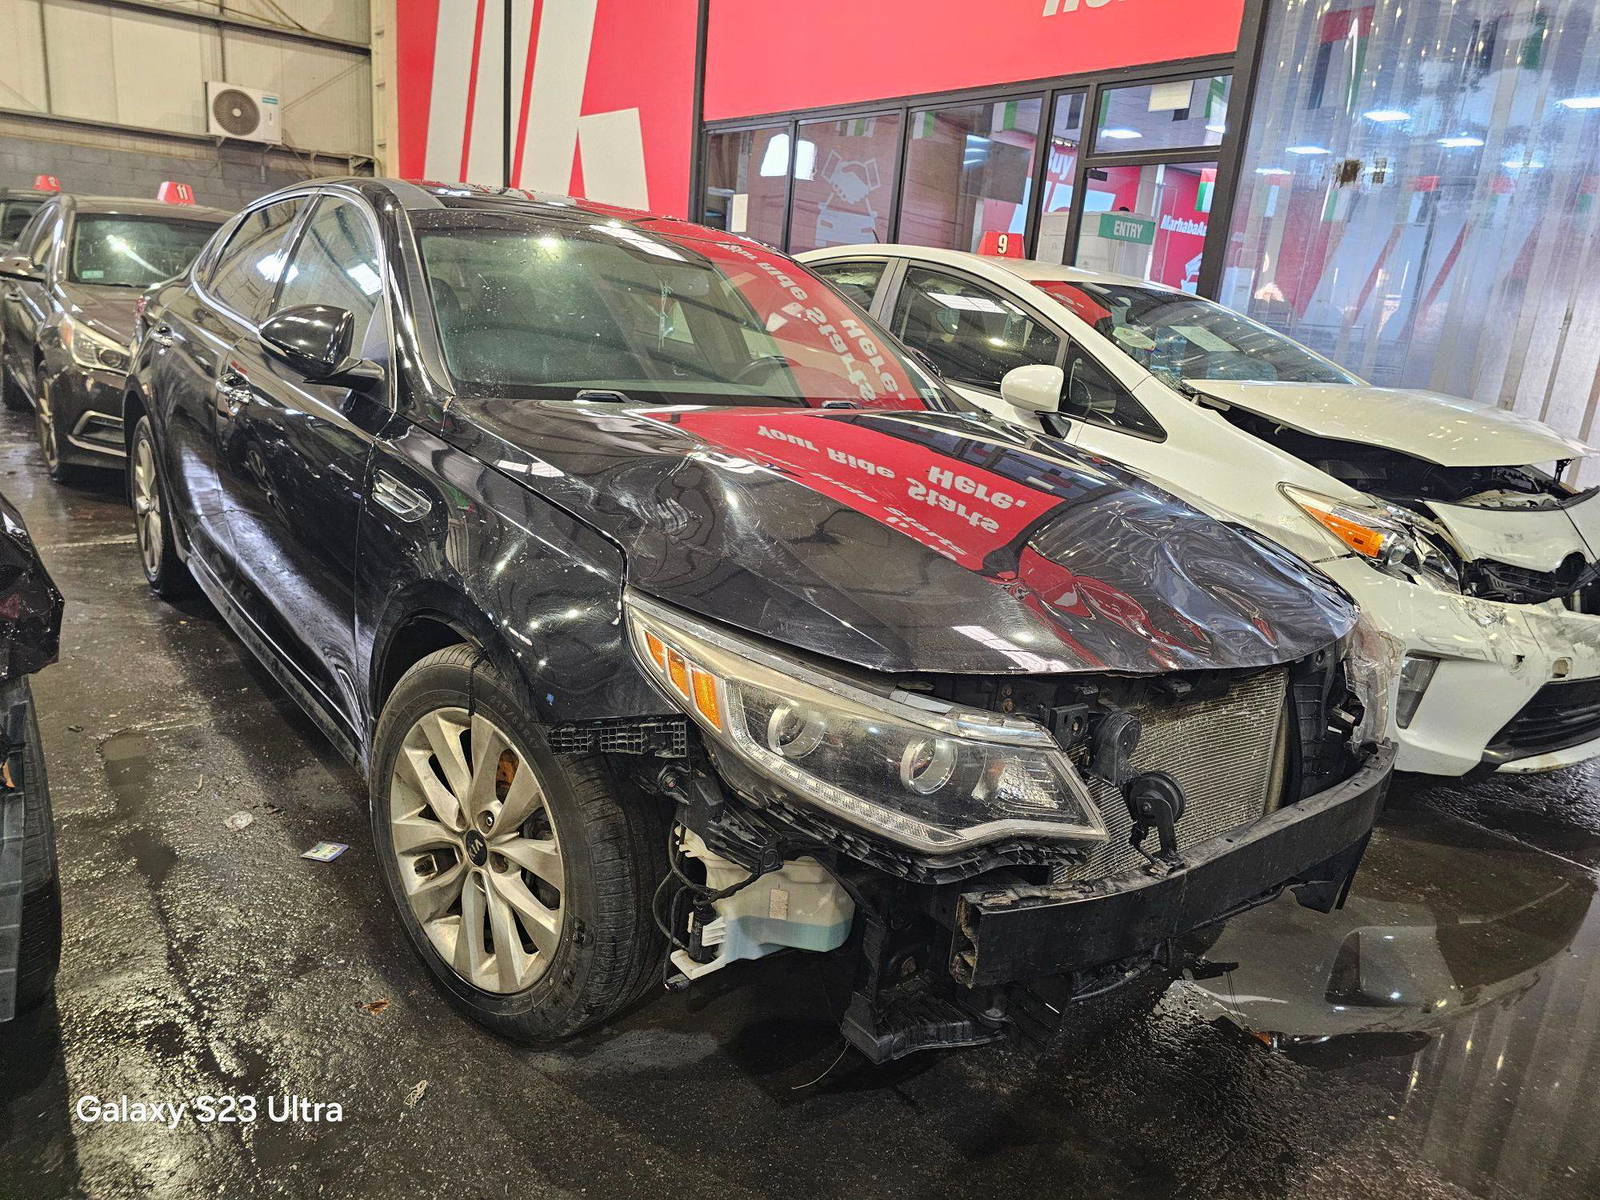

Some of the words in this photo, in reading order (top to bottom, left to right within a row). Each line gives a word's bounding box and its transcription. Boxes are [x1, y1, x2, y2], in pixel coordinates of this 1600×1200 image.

[177, 184, 189, 200] 11
[1113, 220, 1143, 239] ENTRY
[997, 233, 1008, 254] 9
